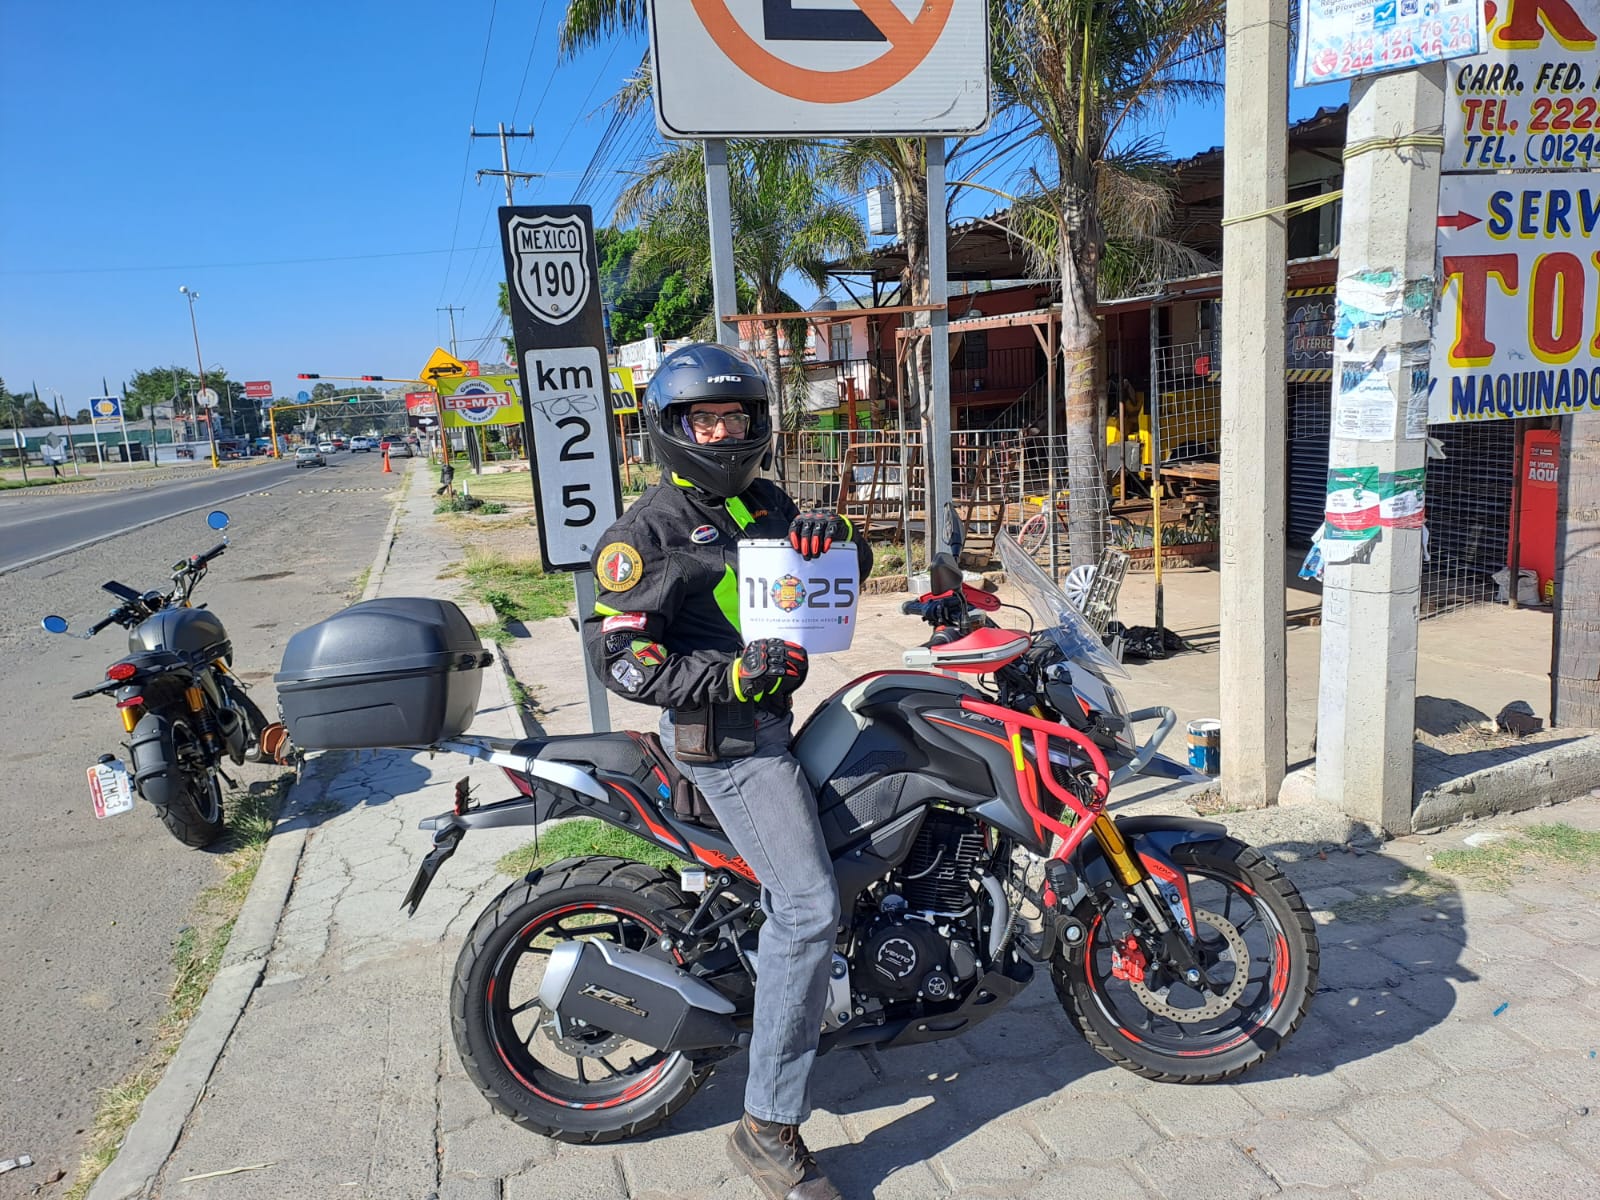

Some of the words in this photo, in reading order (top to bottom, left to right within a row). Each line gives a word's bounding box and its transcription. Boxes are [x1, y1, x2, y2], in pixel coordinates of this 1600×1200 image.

[1450, 13, 1470, 33] 21
[1340, 52, 1373, 73] 244
[1381, 44, 1414, 63] 120
[1421, 39, 1441, 56] 16
[1449, 33, 1471, 50] 49
[1457, 63, 1524, 92] CARR.
[1535, 62, 1585, 91] FED.
[1465, 98, 1519, 132] TEL.
[1465, 135, 1516, 163] TEL.
[1487, 188, 1600, 236] SERV
[521, 229, 577, 249] MEXICO
[530, 260, 576, 297] 190
[1442, 251, 1600, 359] TO
[1295, 338, 1305, 350] LA
[535, 360, 593, 391] km
[555, 416, 595, 461] 2
[1528, 467, 1559, 482] AQUÍ
[562, 483, 596, 527] 5
[745, 577, 768, 608] 11
[807, 578, 855, 608] 25
[885, 948, 910, 963] VENTO
